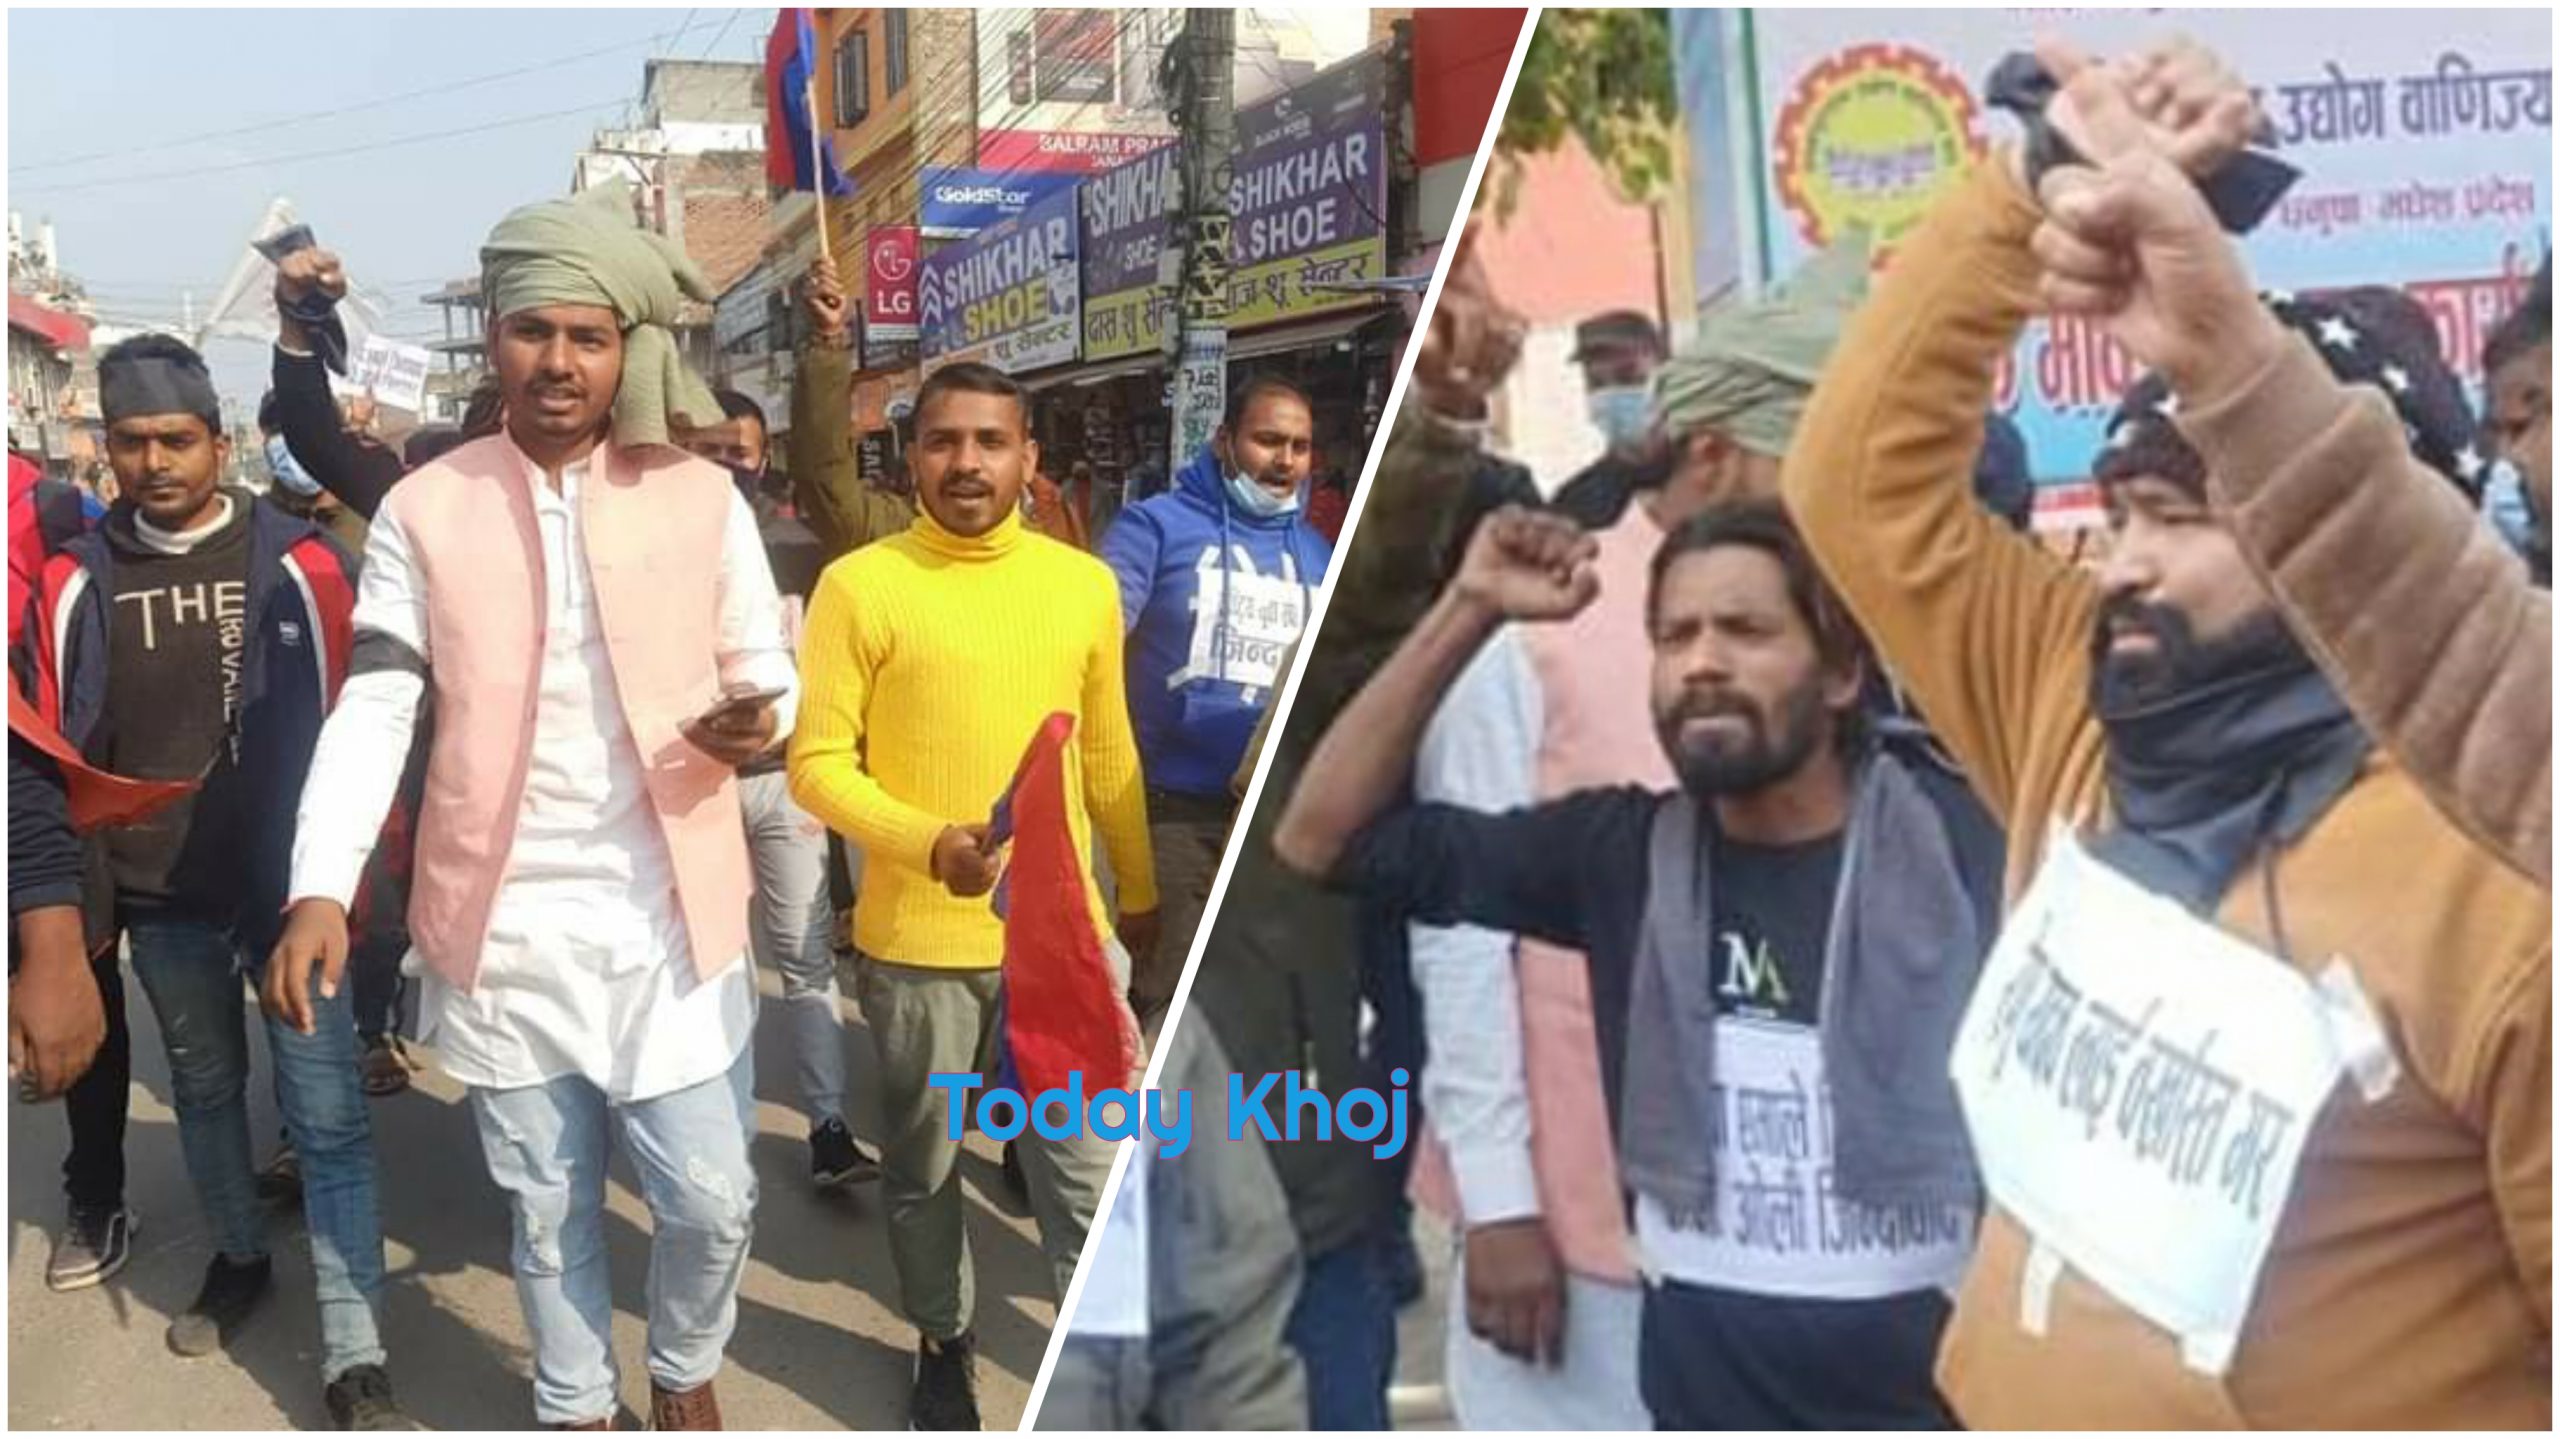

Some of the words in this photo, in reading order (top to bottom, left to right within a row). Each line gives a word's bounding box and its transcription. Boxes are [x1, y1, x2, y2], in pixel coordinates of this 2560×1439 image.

[2276, 60, 2387, 145] उद्योग
[1039, 133, 1119, 153] BALRAM
[1229, 131, 1368, 218] SHIKHAR
[934, 184, 1031, 206] GoldStar
[1124, 235, 1158, 273] SHOE
[1250, 197, 1336, 260] SHOE
[944, 217, 1068, 309] SHIKHAR
[877, 291, 912, 315] LG
[964, 280, 1047, 344] SHOE
[114, 580, 246, 650] THE
